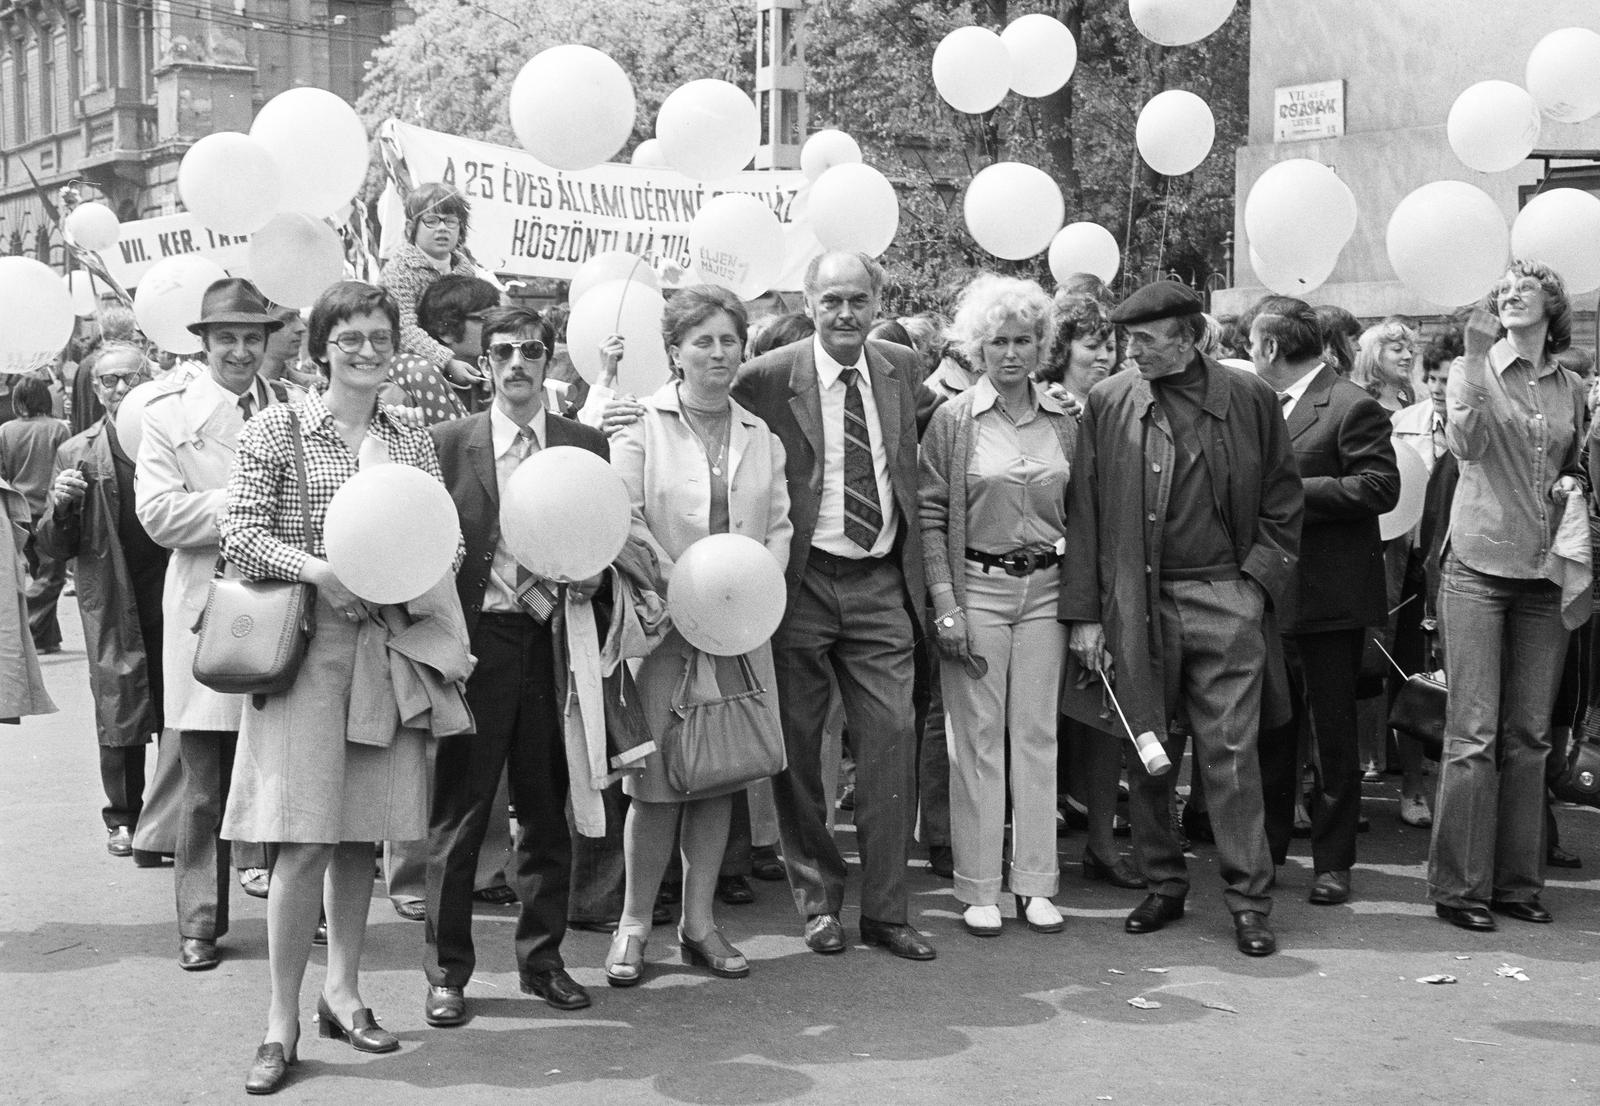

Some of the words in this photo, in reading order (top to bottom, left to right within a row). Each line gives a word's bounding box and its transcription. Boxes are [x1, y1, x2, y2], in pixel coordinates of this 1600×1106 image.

[442, 156, 456, 186] A
[464, 161, 494, 199] 25
[503, 162, 552, 208] ÉVES
[557, 172, 628, 219] ÁLLAMI
[630, 181, 705, 222] DÉRYNÉ
[118, 238, 152, 264] VII.
[158, 229, 201, 257] KER.
[511, 215, 618, 264] KÖSZÖNTI
